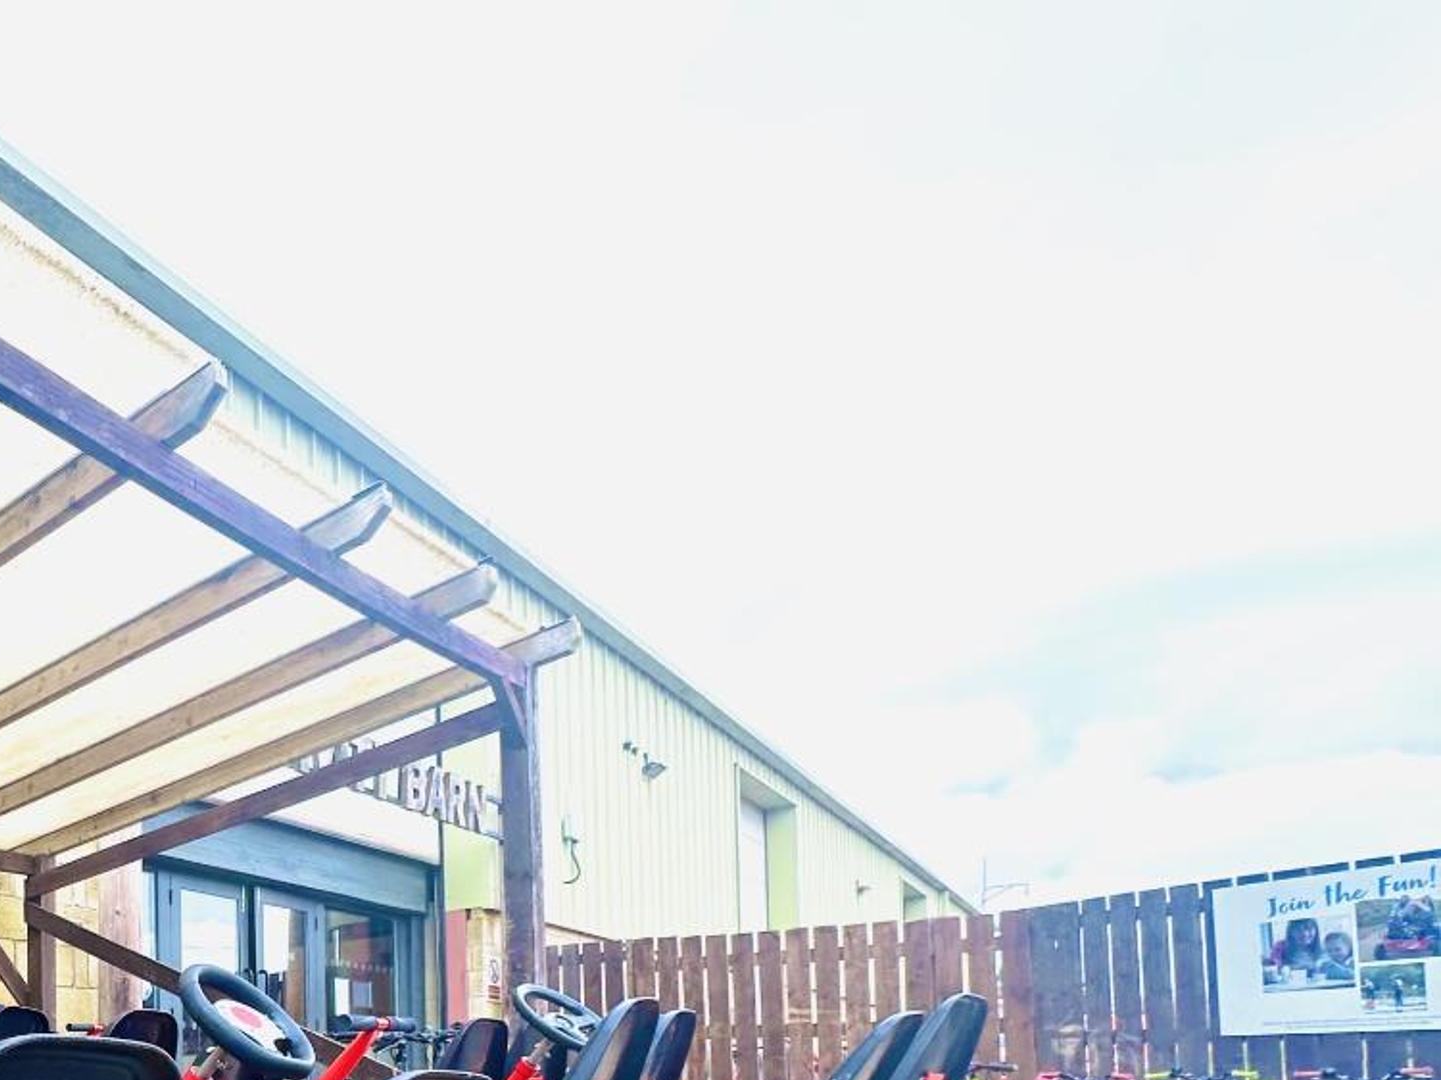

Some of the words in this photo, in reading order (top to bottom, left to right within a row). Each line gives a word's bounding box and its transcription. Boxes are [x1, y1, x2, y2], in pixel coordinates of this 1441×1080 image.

[402, 757, 487, 834] BARN
[1268, 897, 1315, 917] Join
[1325, 881, 1367, 906] the
[1378, 865, 1436, 897] Fun!
